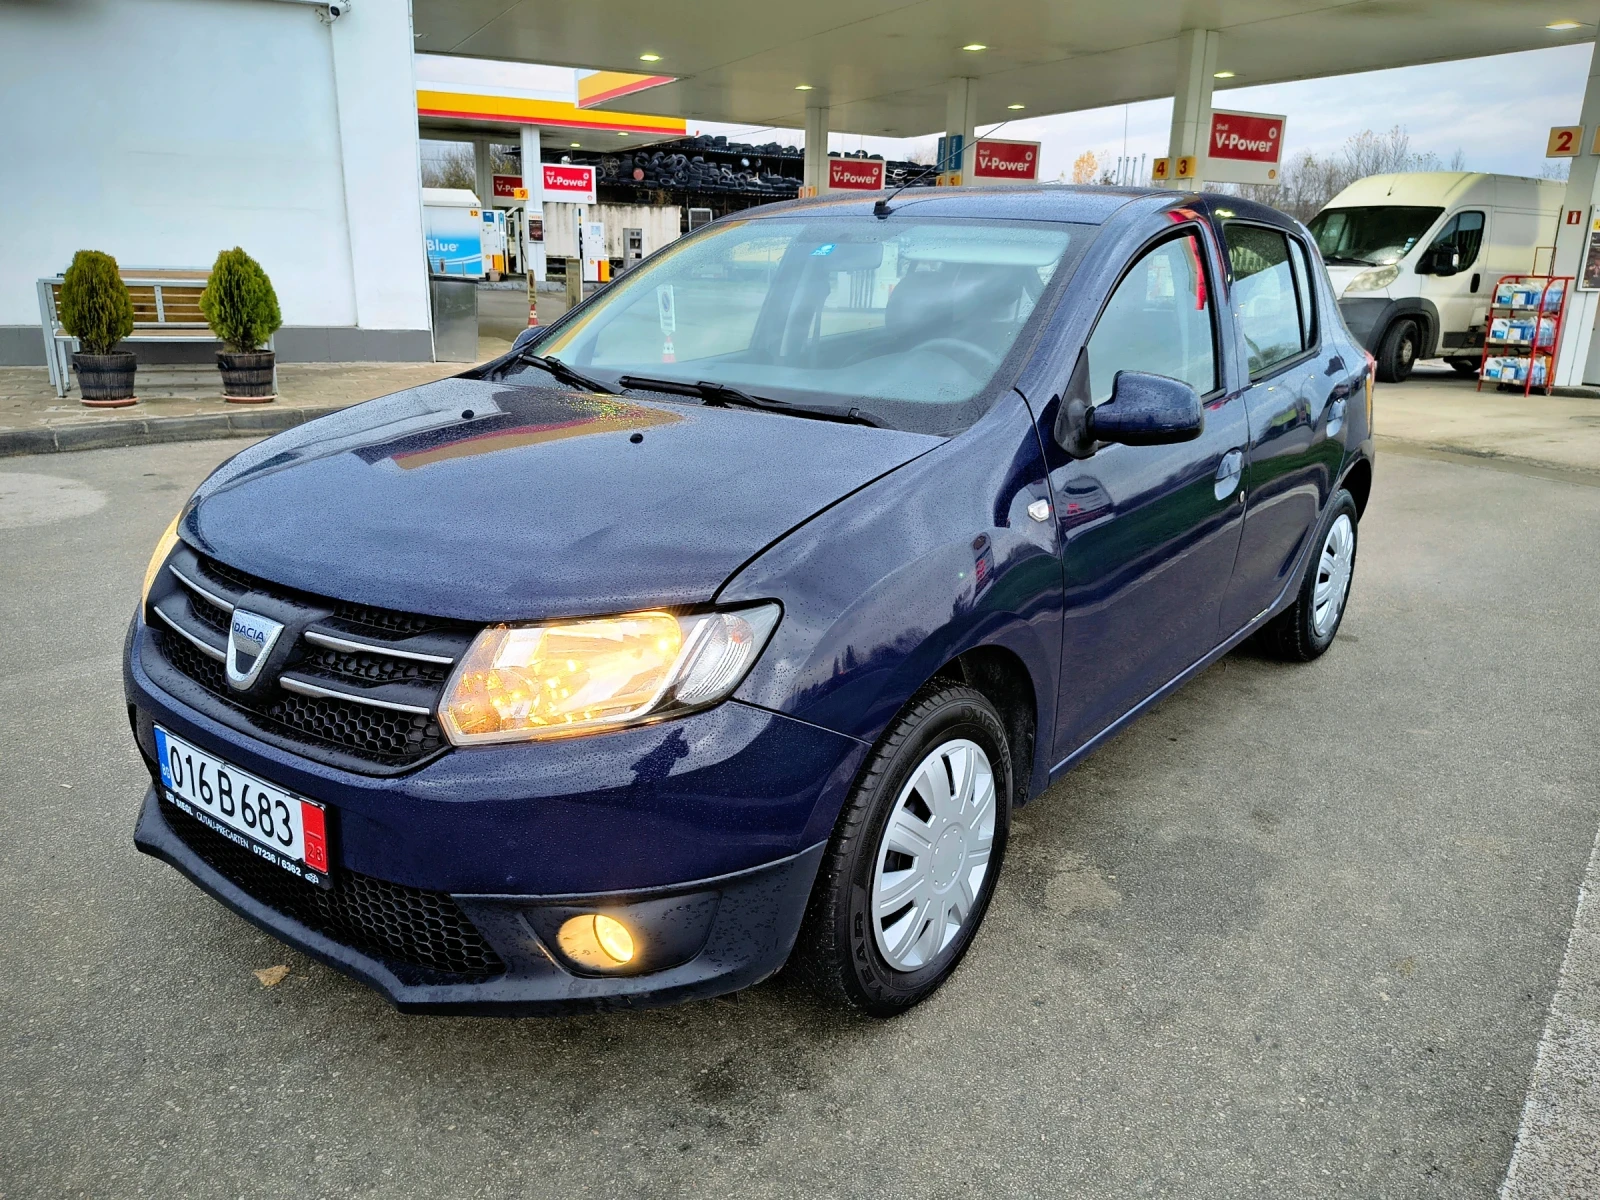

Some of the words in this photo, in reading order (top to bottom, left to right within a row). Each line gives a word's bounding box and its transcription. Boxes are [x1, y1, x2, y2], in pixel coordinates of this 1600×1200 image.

[1216, 123, 1229, 131] Shell
[1215, 133, 1273, 153] V-Power
[1555, 131, 1573, 152] 2
[979, 156, 1030, 172] V-Power
[1156, 161, 1165, 176] 4
[1179, 159, 1188, 175] 3
[546, 175, 588, 187] V-Power
[832, 171, 877, 184] V-Power
[496, 183, 515, 193] V-Po
[519, 189, 526, 198] 9
[426, 239, 457, 252] Blue
[233, 622, 264, 643] DACIA
[161, 763, 171, 779] BG
[170, 745, 294, 847] 016B683
[252, 844, 277, 864] 07236
[281, 859, 302, 877] 6362
